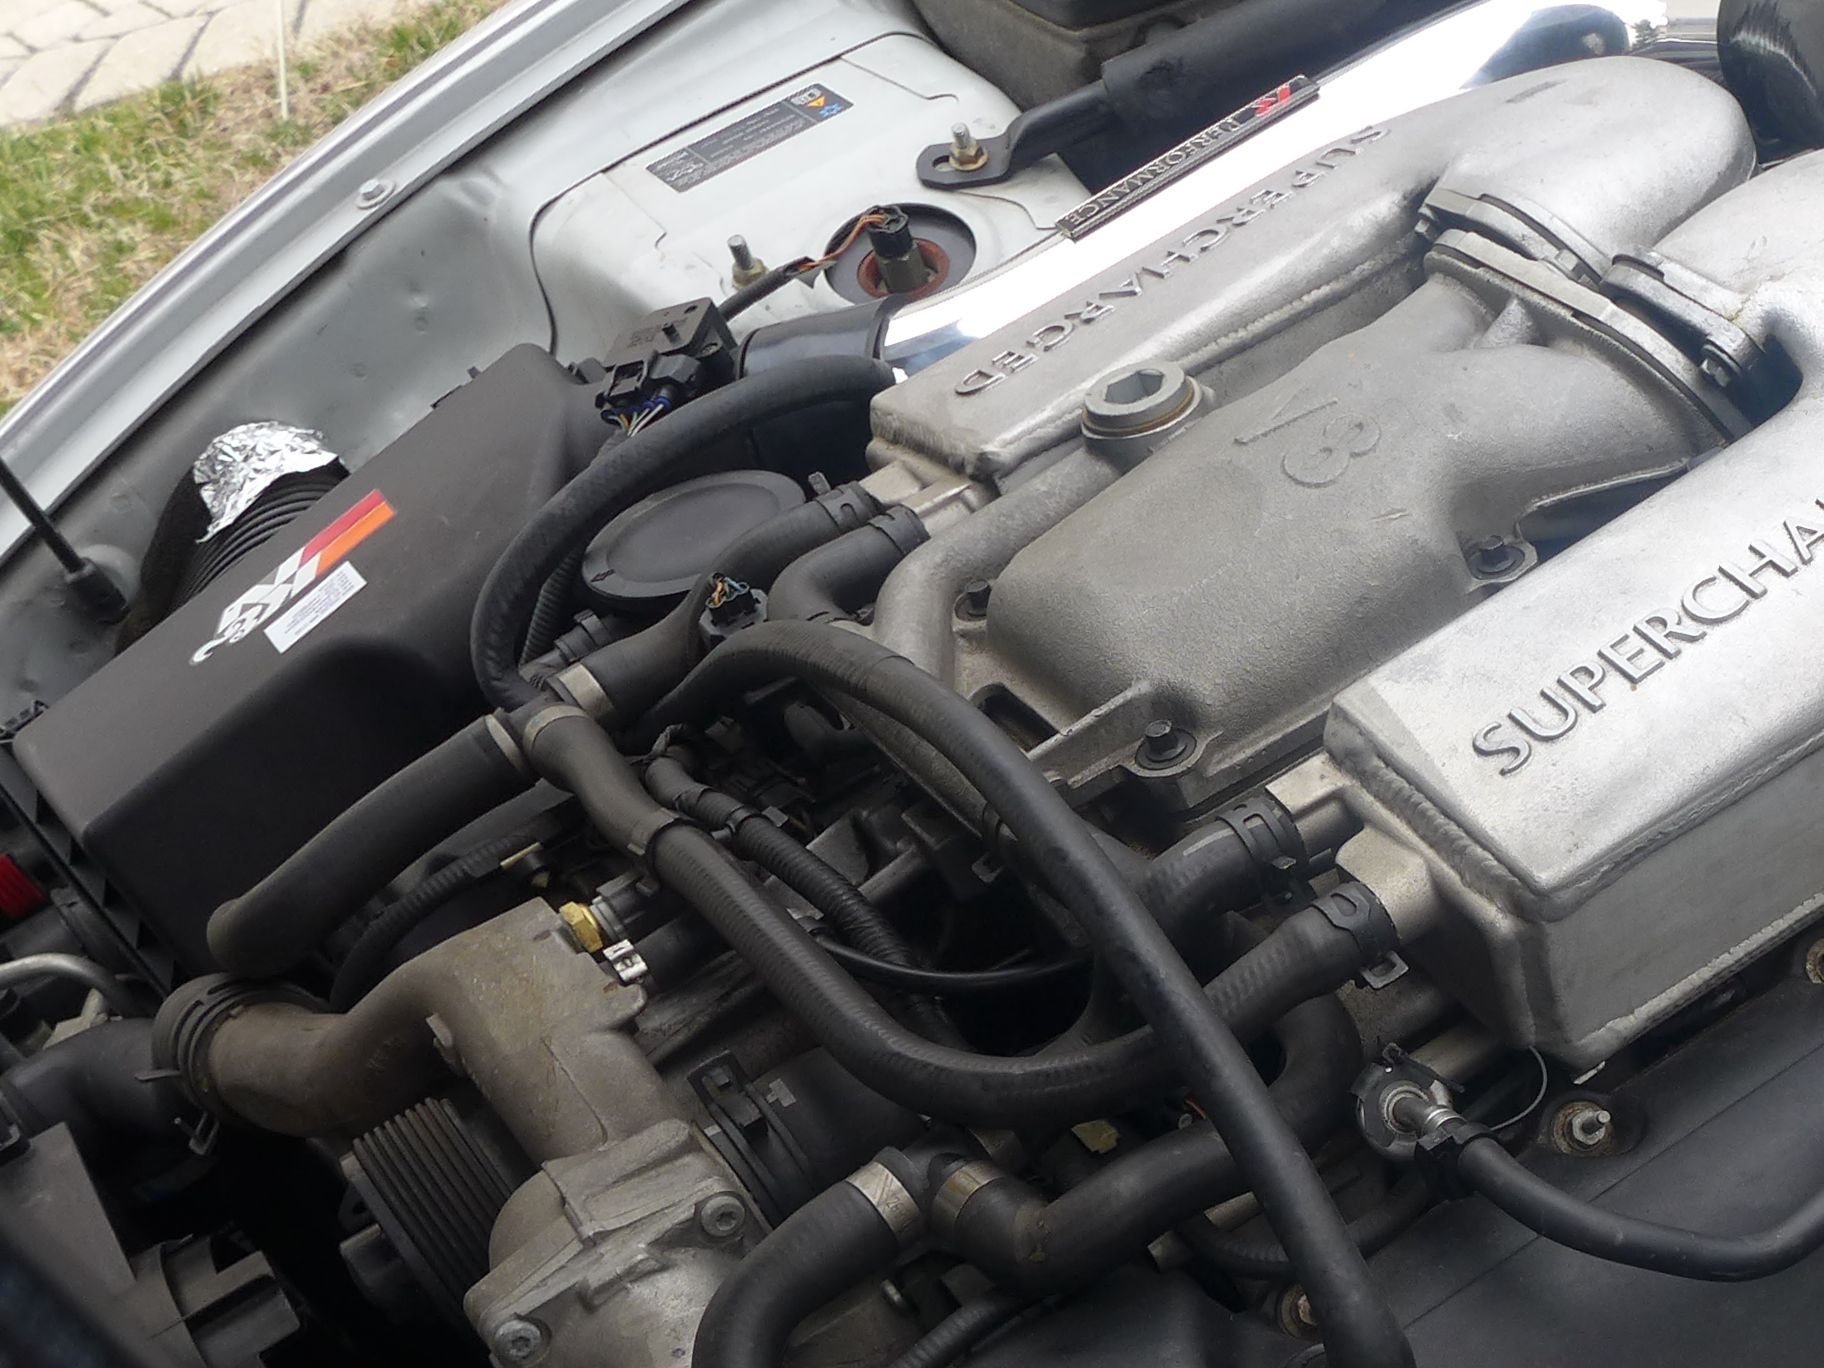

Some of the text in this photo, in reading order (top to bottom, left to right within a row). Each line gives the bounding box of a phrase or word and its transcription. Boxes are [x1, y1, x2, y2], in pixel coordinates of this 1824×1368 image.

[1065, 117, 1240, 225] PERFORMANCE
[955, 124, 1391, 396] SUPERCHARGED
[1233, 395, 1382, 489] V8
